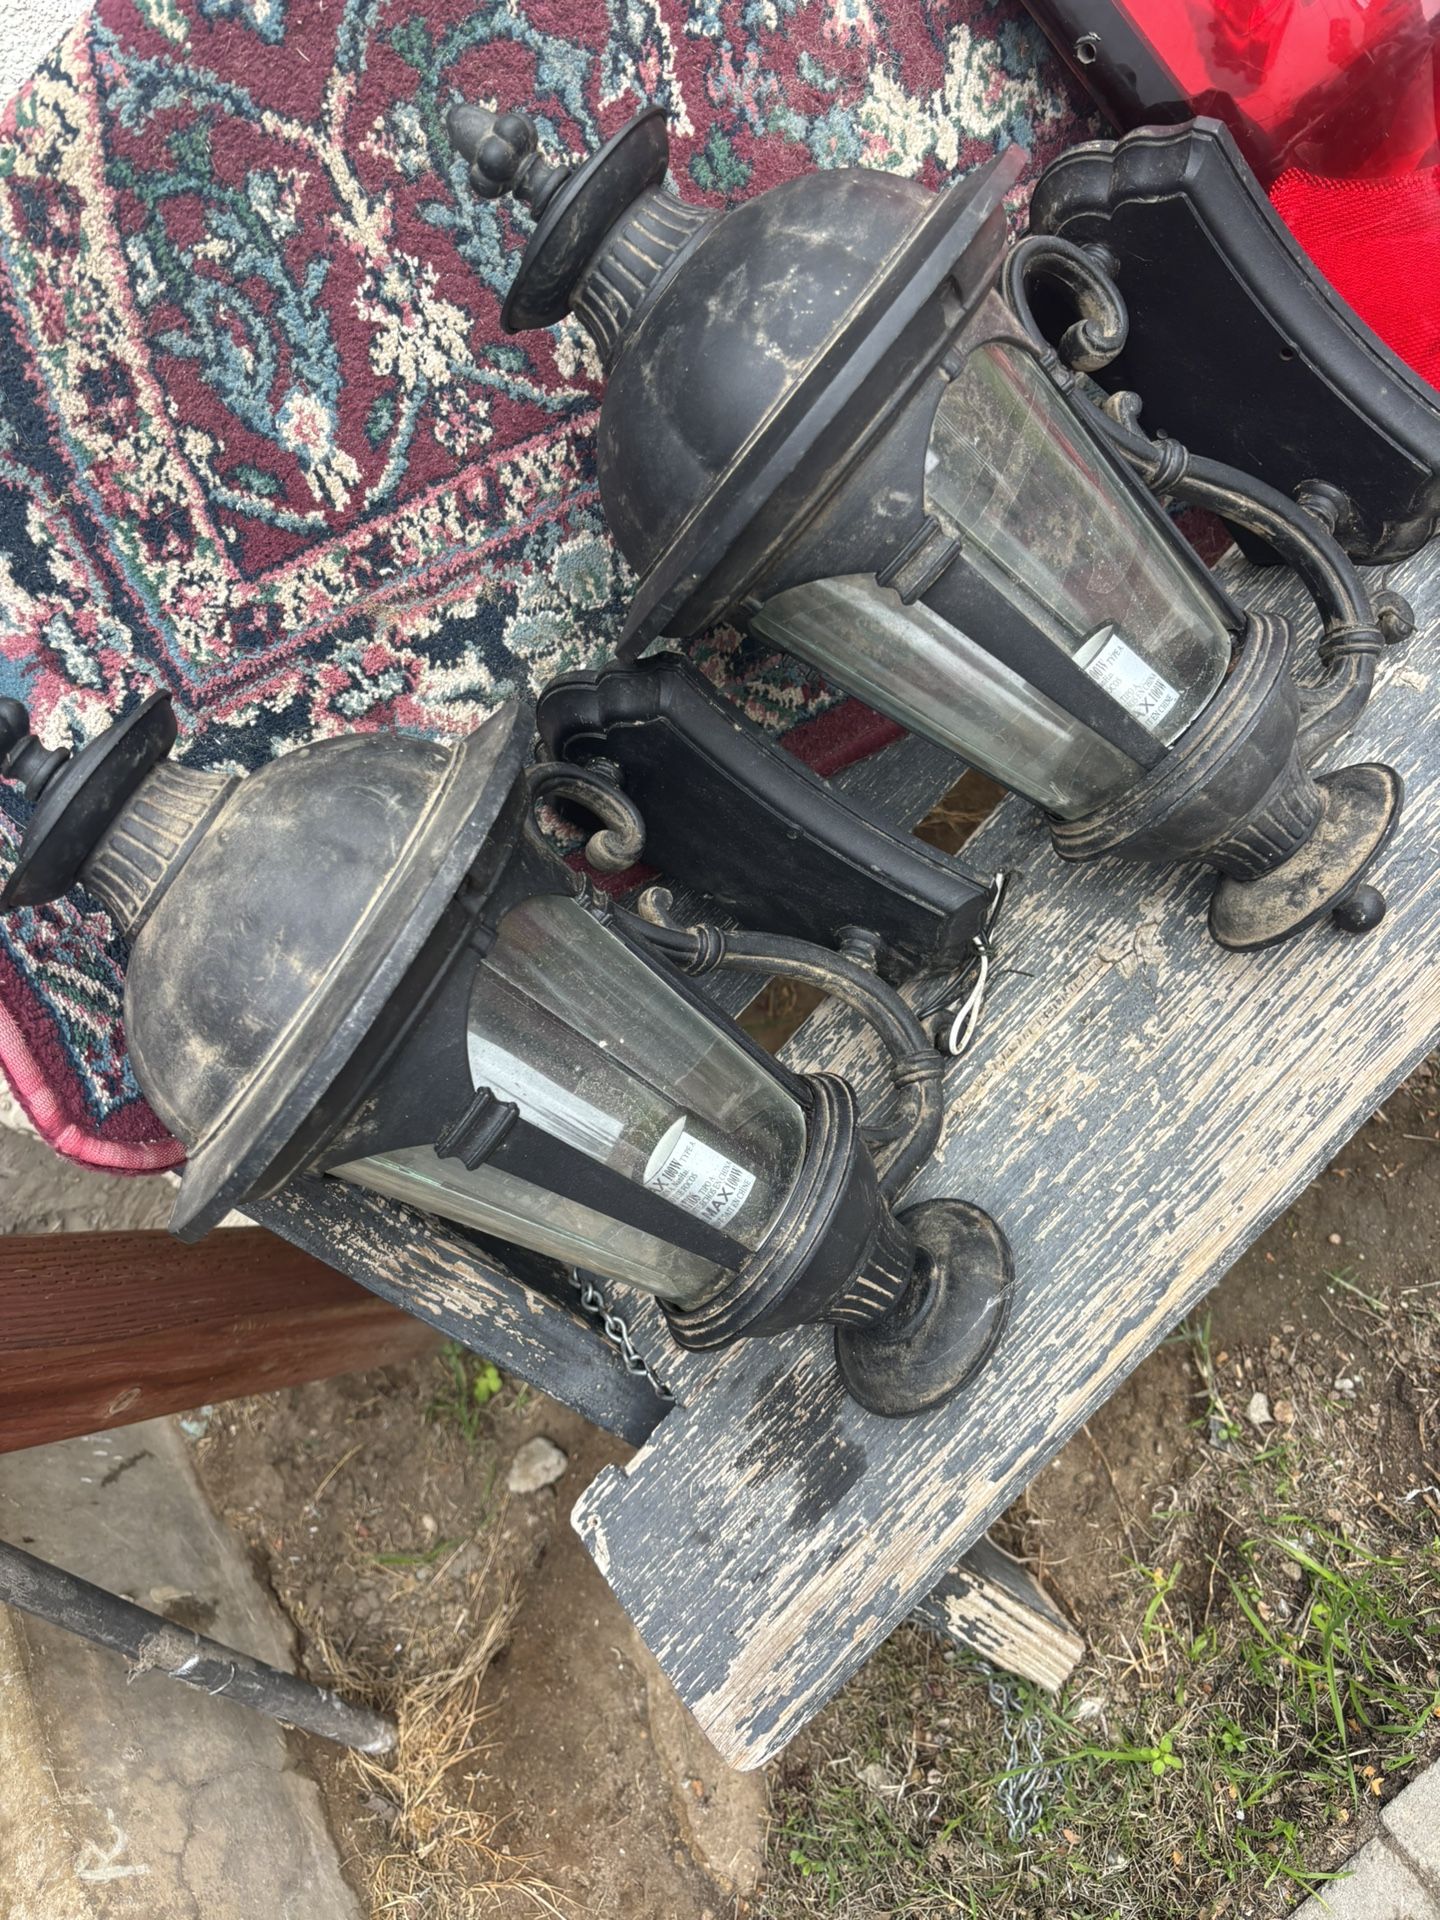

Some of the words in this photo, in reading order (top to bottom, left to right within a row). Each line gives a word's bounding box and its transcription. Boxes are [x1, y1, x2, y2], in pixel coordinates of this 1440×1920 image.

[1132, 696, 1155, 718] AX
[1148, 678, 1167, 702] 100W
[649, 1178, 669, 1195] AX
[662, 1158, 682, 1181] 100W
[701, 1186, 734, 1220] MAX
[724, 1165, 743, 1190] 100W
